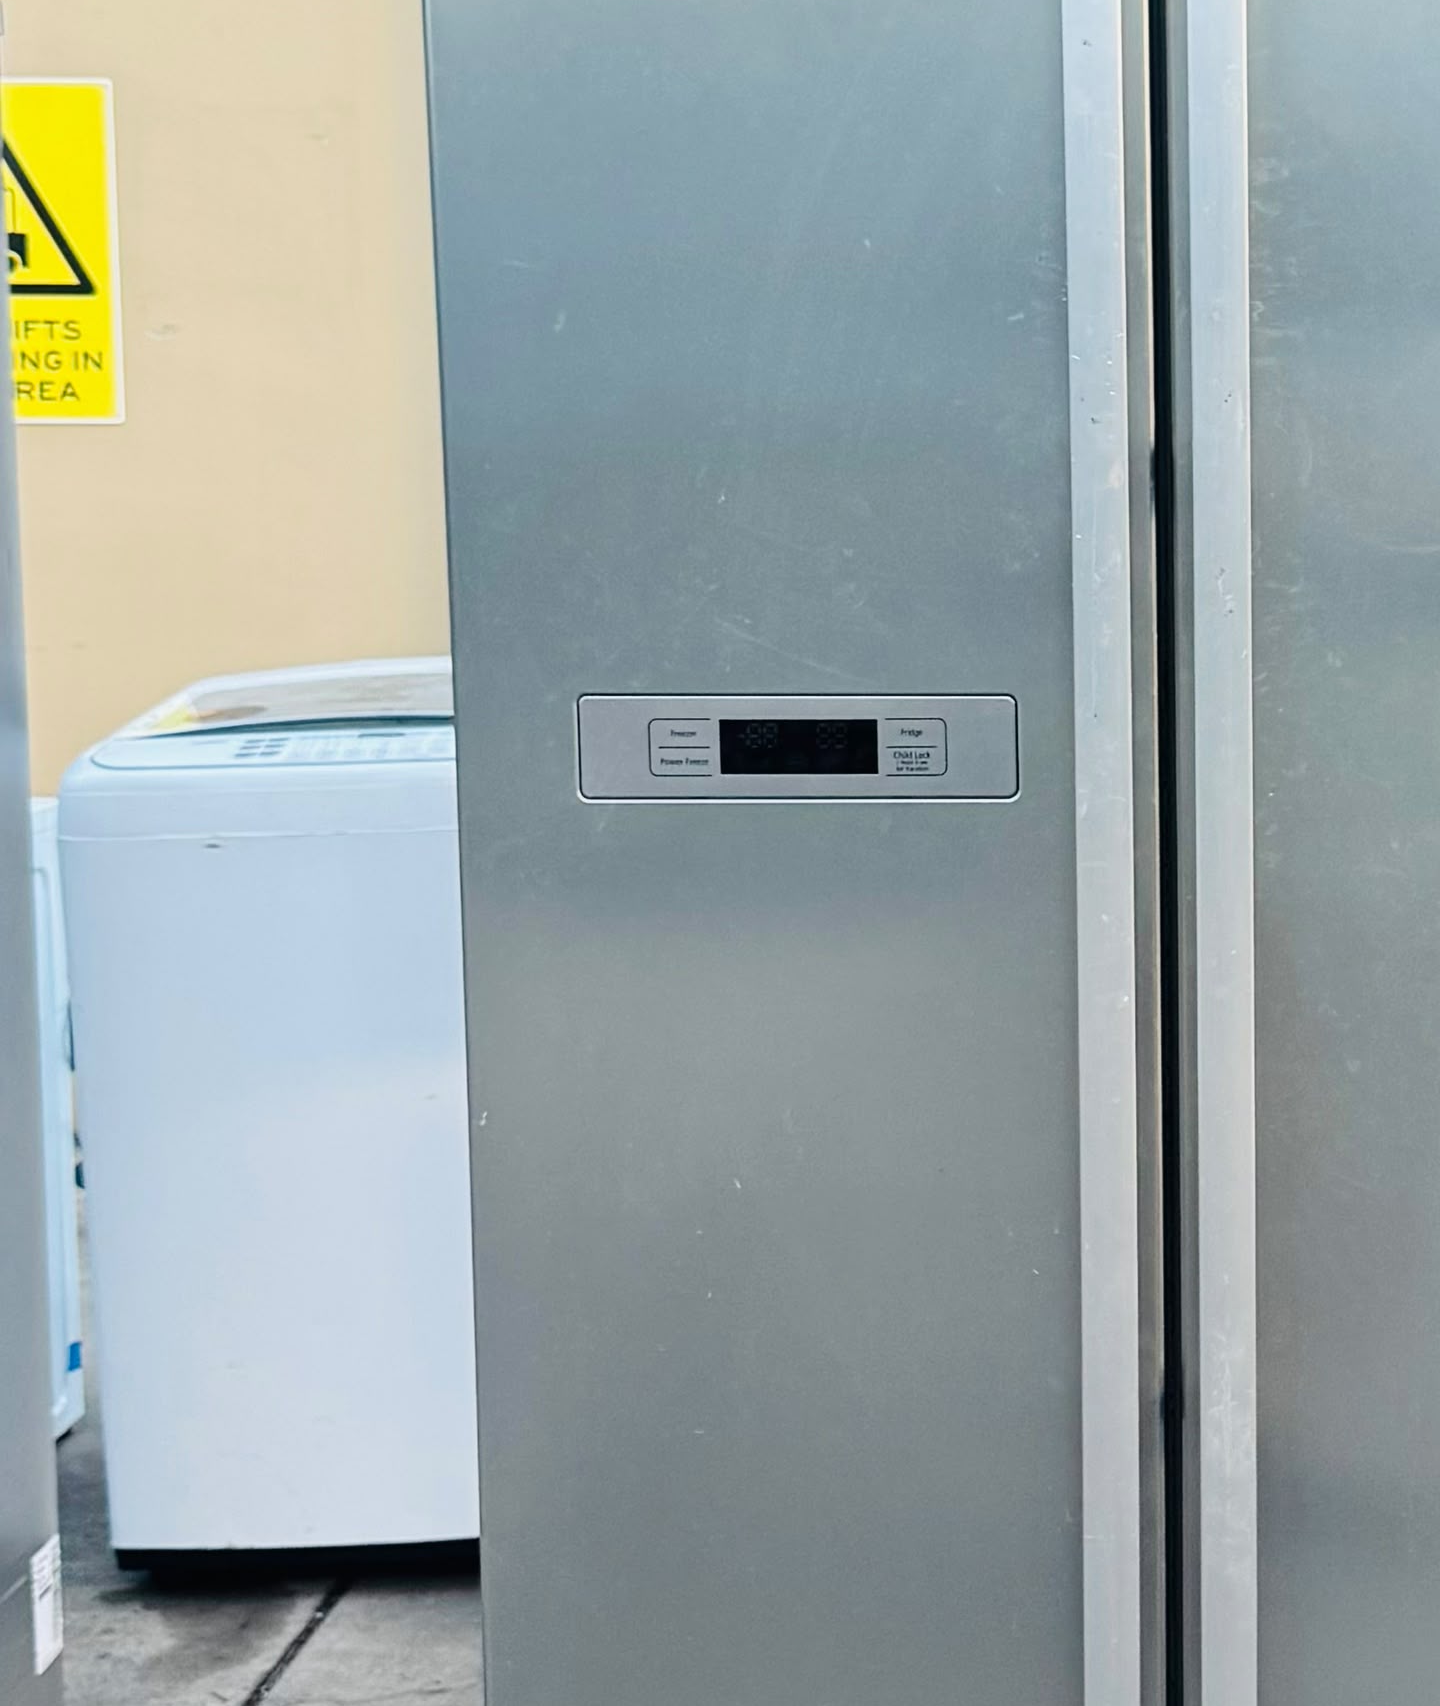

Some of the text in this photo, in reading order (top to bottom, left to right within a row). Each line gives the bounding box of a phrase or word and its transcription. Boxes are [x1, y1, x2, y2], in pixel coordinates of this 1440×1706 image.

[14, 319, 82, 341] IFTS
[73, 350, 103, 372] IN
[15, 380, 81, 401] REA
[900, 728, 923, 738] Fridge
[893, 751, 930, 759] Child Lock
